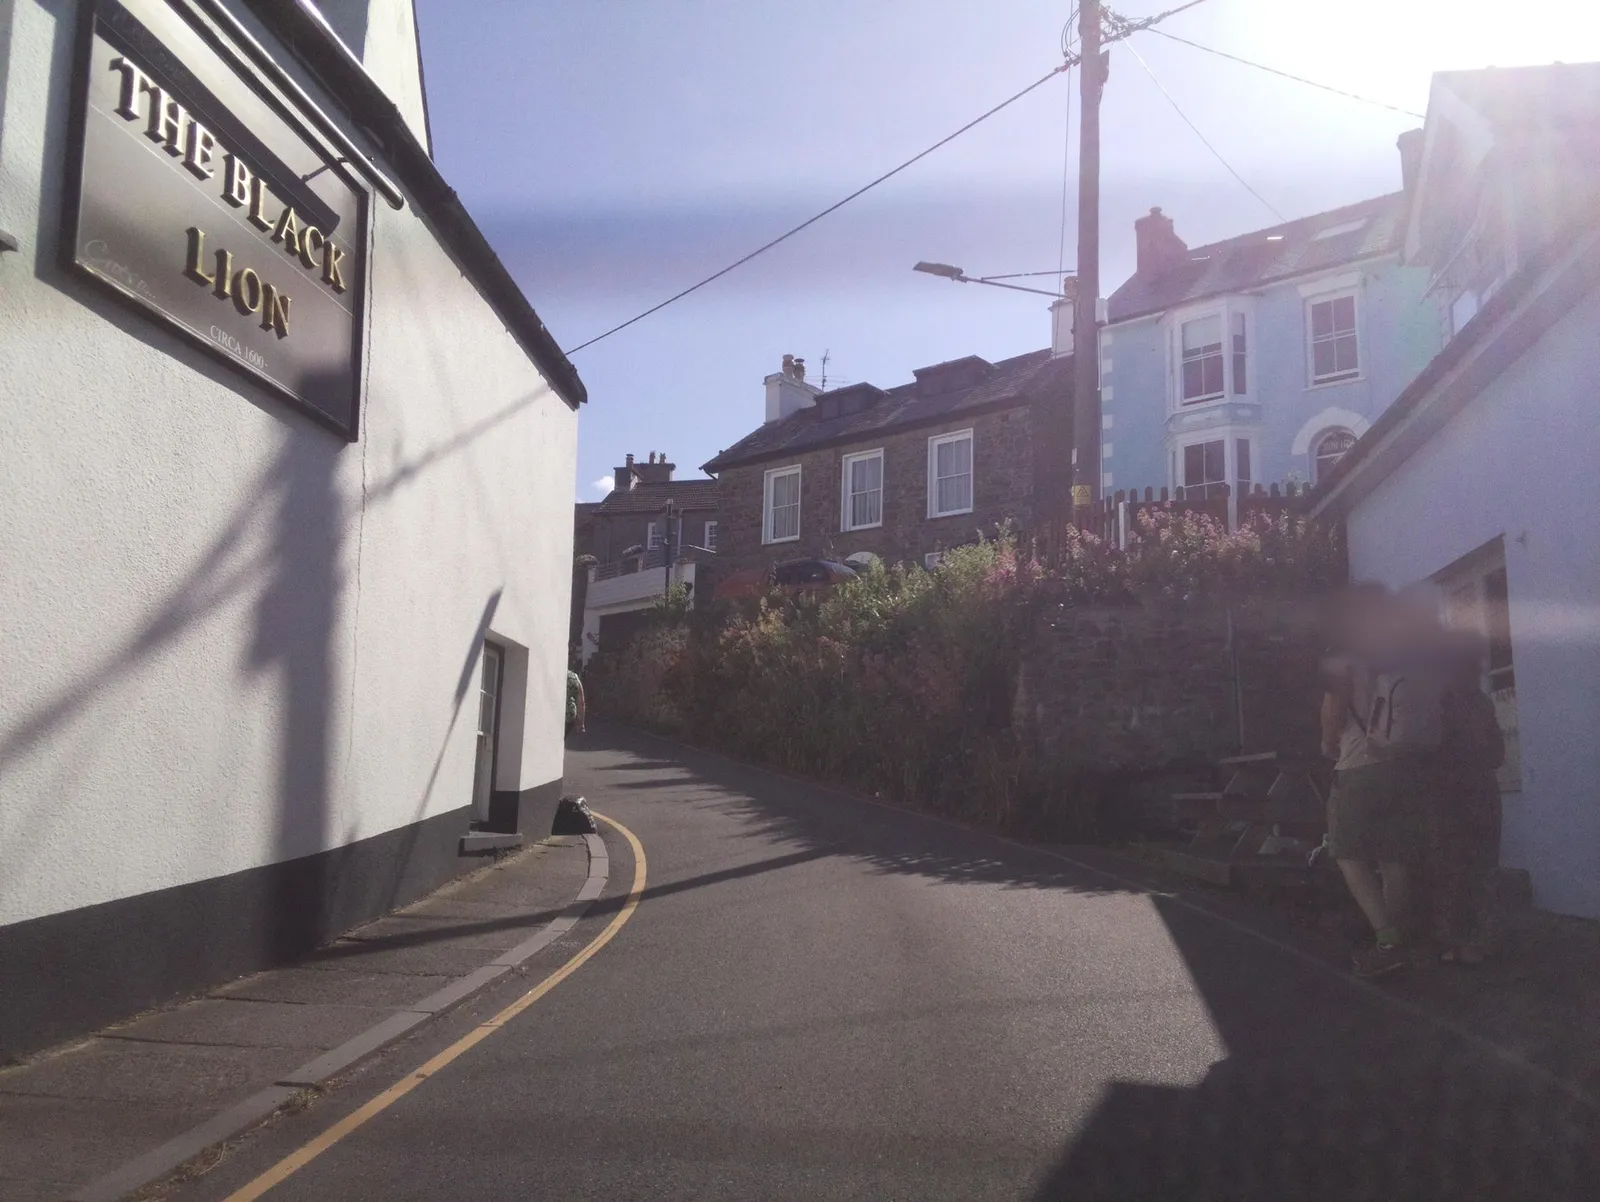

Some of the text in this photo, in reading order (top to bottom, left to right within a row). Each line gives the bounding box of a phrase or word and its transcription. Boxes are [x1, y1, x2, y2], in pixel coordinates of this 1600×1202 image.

[110, 57, 216, 181] THE
[222, 154, 346, 293] BLACK
[184, 227, 293, 339] LION
[210, 325, 241, 355] CIRCA
